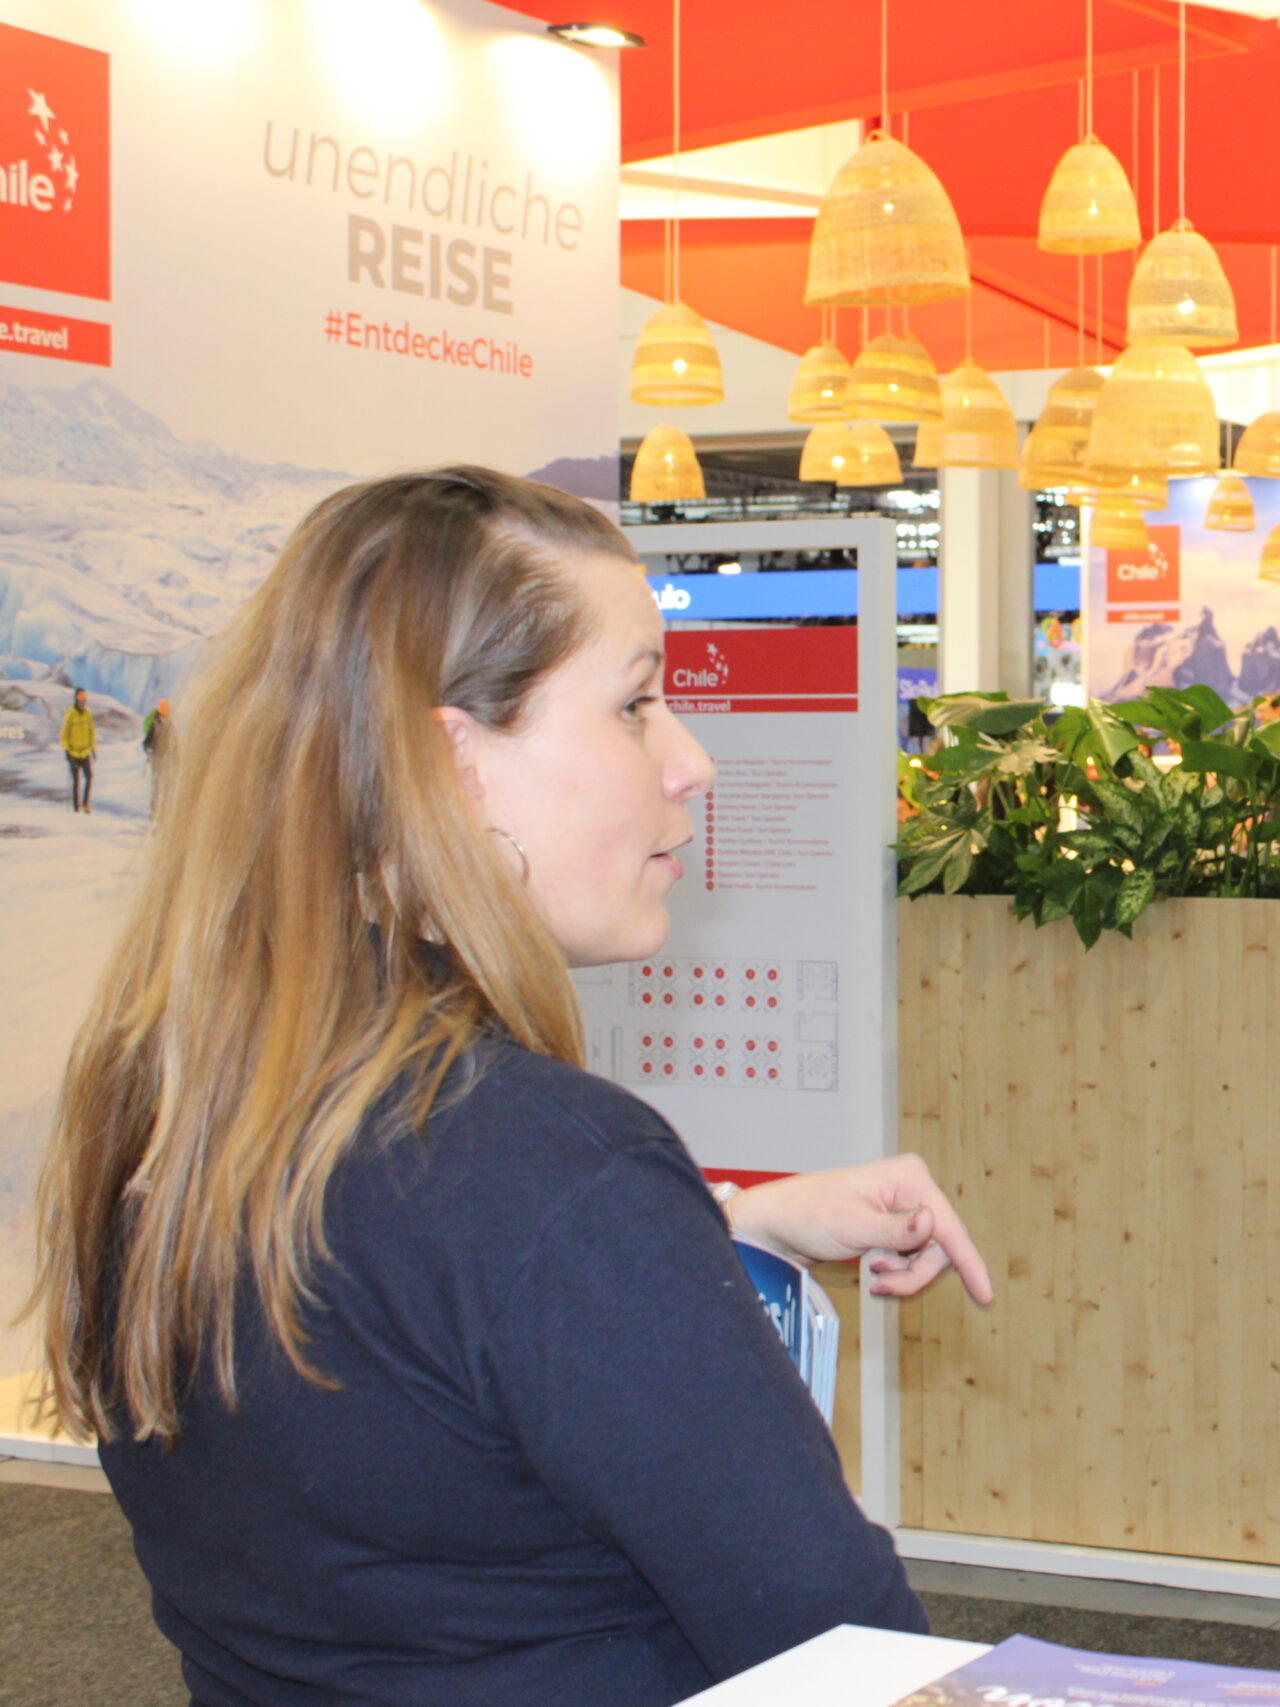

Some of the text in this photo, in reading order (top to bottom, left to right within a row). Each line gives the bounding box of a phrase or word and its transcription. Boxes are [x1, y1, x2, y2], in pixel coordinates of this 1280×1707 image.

[263, 120, 584, 251] unendliche
[347, 212, 514, 316] REISE
[323, 308, 534, 378] #EntdeckeChile
[1117, 563, 1159, 581] Chile
[672, 668, 719, 688] Chile
